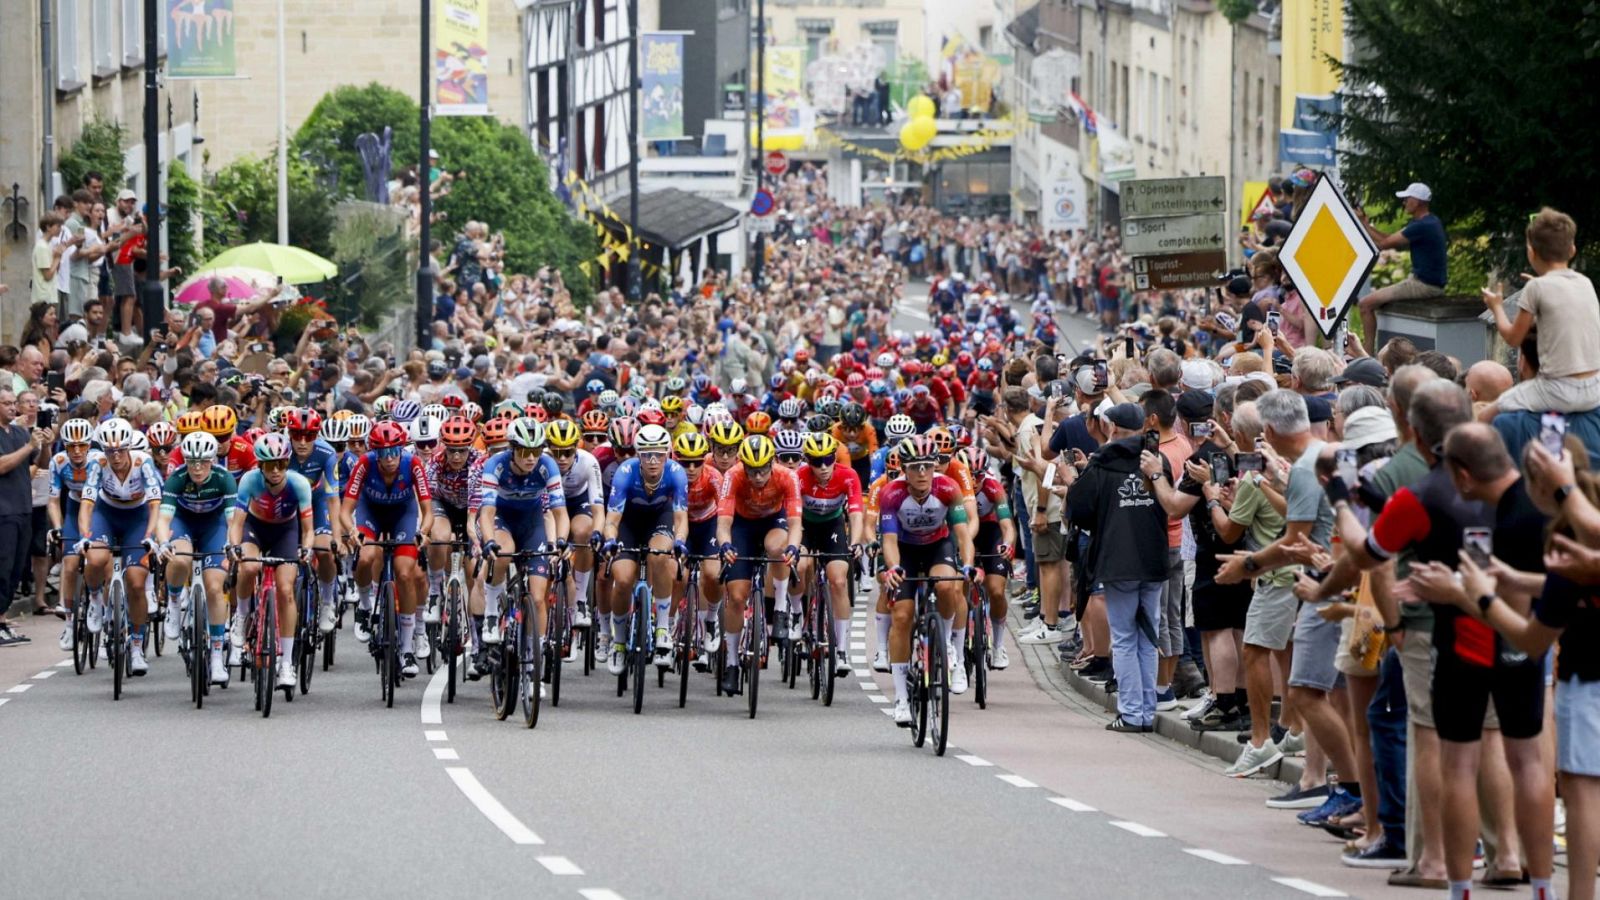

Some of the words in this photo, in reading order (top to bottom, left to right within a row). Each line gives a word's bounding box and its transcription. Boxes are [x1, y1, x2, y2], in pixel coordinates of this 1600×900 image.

[1140, 184, 1185, 195] Openbare
[1151, 199, 1210, 210] instellingen
[1141, 222, 1166, 234] Sport
[1159, 236, 1208, 247] complexen
[1149, 260, 1183, 271] Tourist-
[1161, 272, 1210, 283] information
[348, 463, 366, 495] CERATIZIT
[366, 487, 411, 500] CERATIZIT
